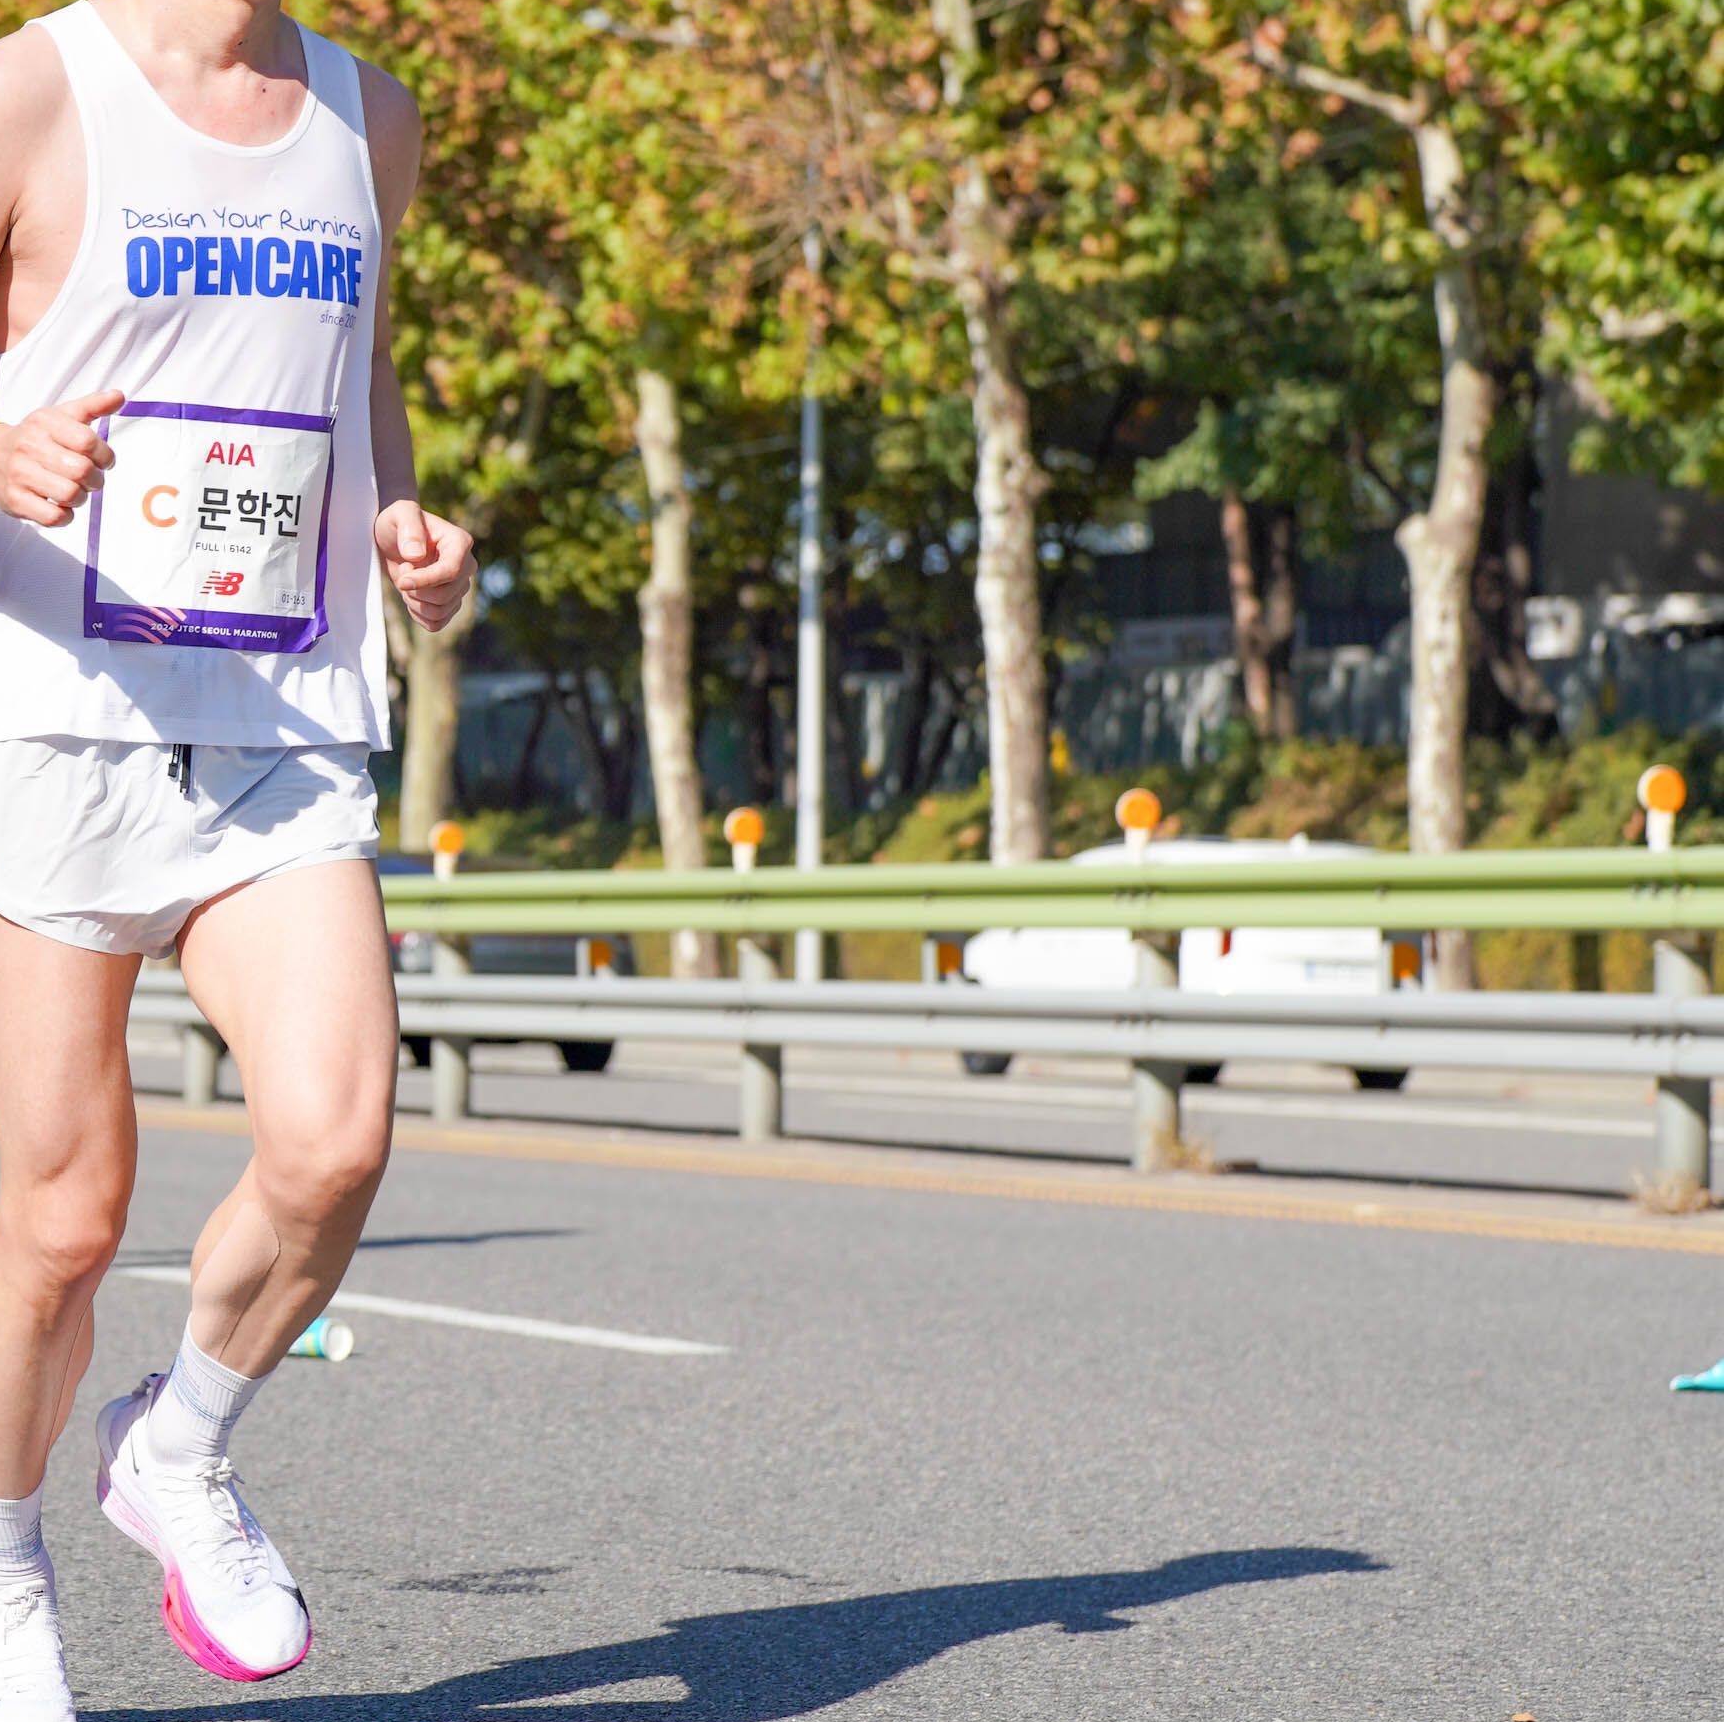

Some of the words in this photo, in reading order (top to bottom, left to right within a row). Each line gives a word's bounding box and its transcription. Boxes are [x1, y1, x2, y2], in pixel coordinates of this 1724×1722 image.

[122, 207, 206, 230] Design
[213, 206, 272, 229] Your
[280, 209, 362, 242] Running
[126, 236, 363, 308] OPENCARE
[319, 309, 345, 327] since
[205, 441, 256, 467] AIA
[142, 484, 180, 528] C
[197, 487, 302, 537] 문학진
[195, 542, 220, 552] FULL
[151, 622, 175, 632] 2024
[177, 623, 201, 634] JTBC
[201, 626, 232, 636] SEOUL
[233, 628, 278, 640] MARATHON
